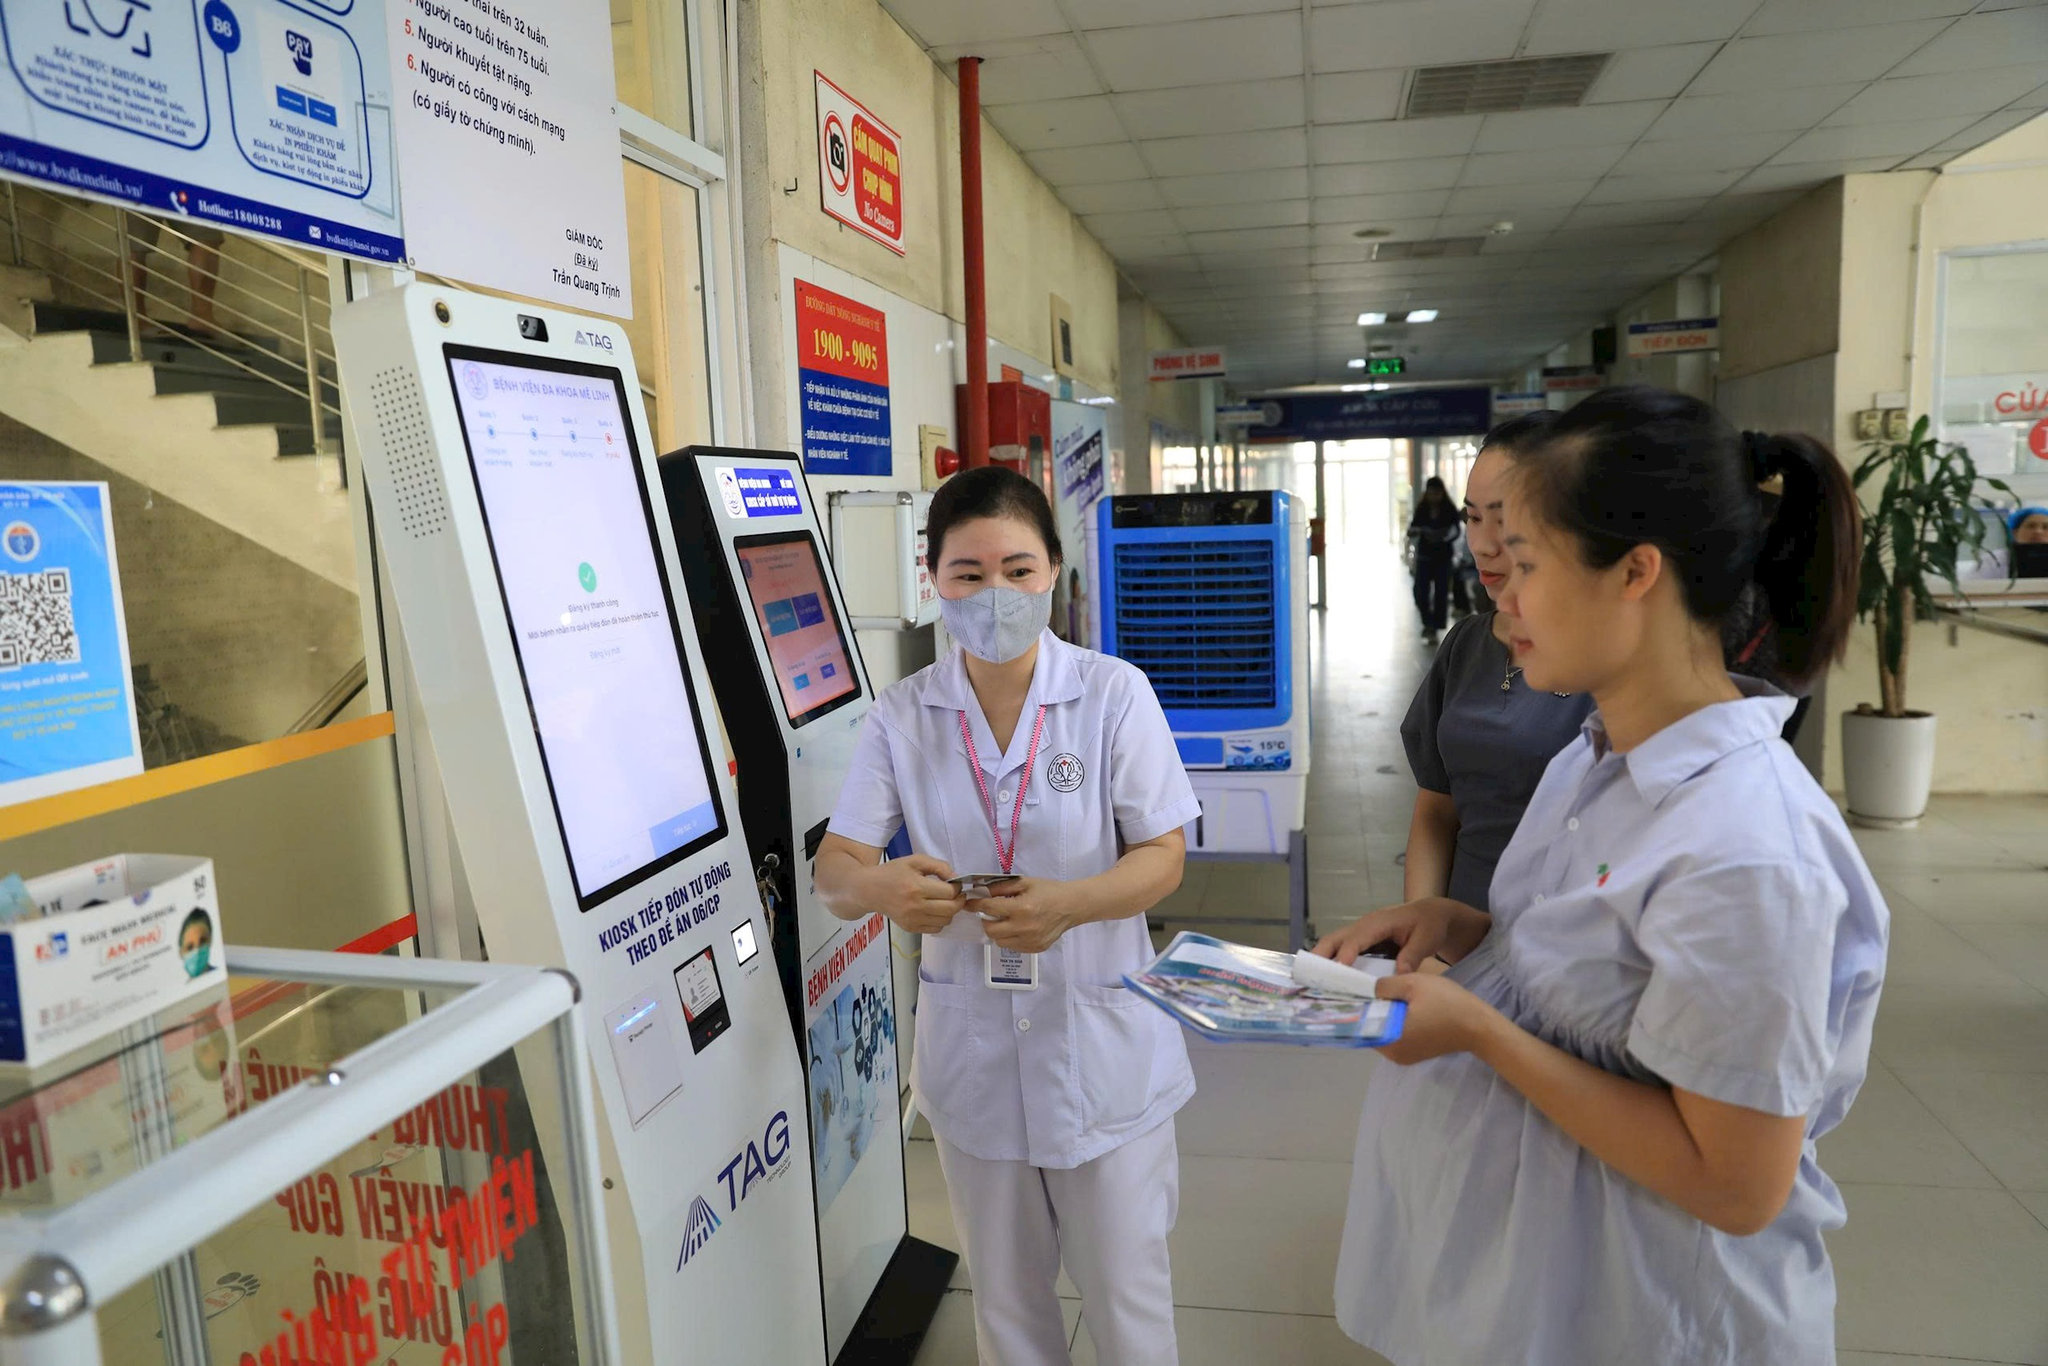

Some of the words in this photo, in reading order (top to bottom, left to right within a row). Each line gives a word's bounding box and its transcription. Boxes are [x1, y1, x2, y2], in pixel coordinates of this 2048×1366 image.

[454, 16, 472, 34] cao
[476, 26, 494, 46] tuổi
[497, 38, 515, 58] trên
[518, 48, 528, 64] 75
[530, 56, 550, 76] tuổi.
[494, 6, 512, 27] trên
[514, 17, 525, 34] 32
[527, 26, 549, 48] tuần.
[404, 19, 414, 36] 5.
[418, 25, 452, 55] Người
[456, 44, 490, 74] khuyết
[493, 64, 505, 82] tật
[508, 72, 533, 97] nặng.
[408, 54, 416, 71] 6.
[420, 60, 455, 88] Người
[458, 80, 470, 96] có
[474, 87, 498, 110] công
[501, 99, 516, 116] với
[518, 105, 539, 127] cách
[541, 119, 566, 142] mạng
[413, 90, 430, 110] (có
[434, 99, 456, 125] giấy
[460, 110, 470, 126] tờ
[473, 116, 505, 145] chứng
[508, 132, 536, 155] minh).
[566, 227, 586, 246] GIÁM
[864, 200, 873, 221] No
[873, 207, 896, 233] Camera
[552, 268, 572, 286] Trần
[574, 273, 598, 296] Quang
[601, 278, 620, 300] Trịnh
[586, 332, 613, 350] TAG
[813, 328, 842, 362] 1900
[852, 340, 878, 371] 9095
[1370, 358, 1401, 374] EXIT
[493, 378, 518, 393] BỆNH
[520, 379, 541, 395] VIỆN
[542, 384, 554, 395] ĐA
[555, 386, 578, 399] KHOA
[592, 390, 610, 402] LINH
[1260, 740, 1286, 750] 15°C
[599, 915, 639, 952] KIOSK
[638, 896, 664, 929] TIẾP
[664, 886, 690, 914] ĐÓN
[689, 874, 704, 900] TỰ
[704, 860, 732, 890] ĐỘNG
[626, 934, 658, 966] THEO
[658, 916, 675, 948] ĐỀ
[676, 912, 692, 937] ÁN
[692, 893, 721, 926] 06/CP
[808, 968, 828, 1008] BỆNH
[828, 946, 845, 984] VIỆN
[846, 924, 867, 966] THÔNG
[718, 1110, 790, 1212] TAG
[440, 1149, 538, 1292] THIỆN
